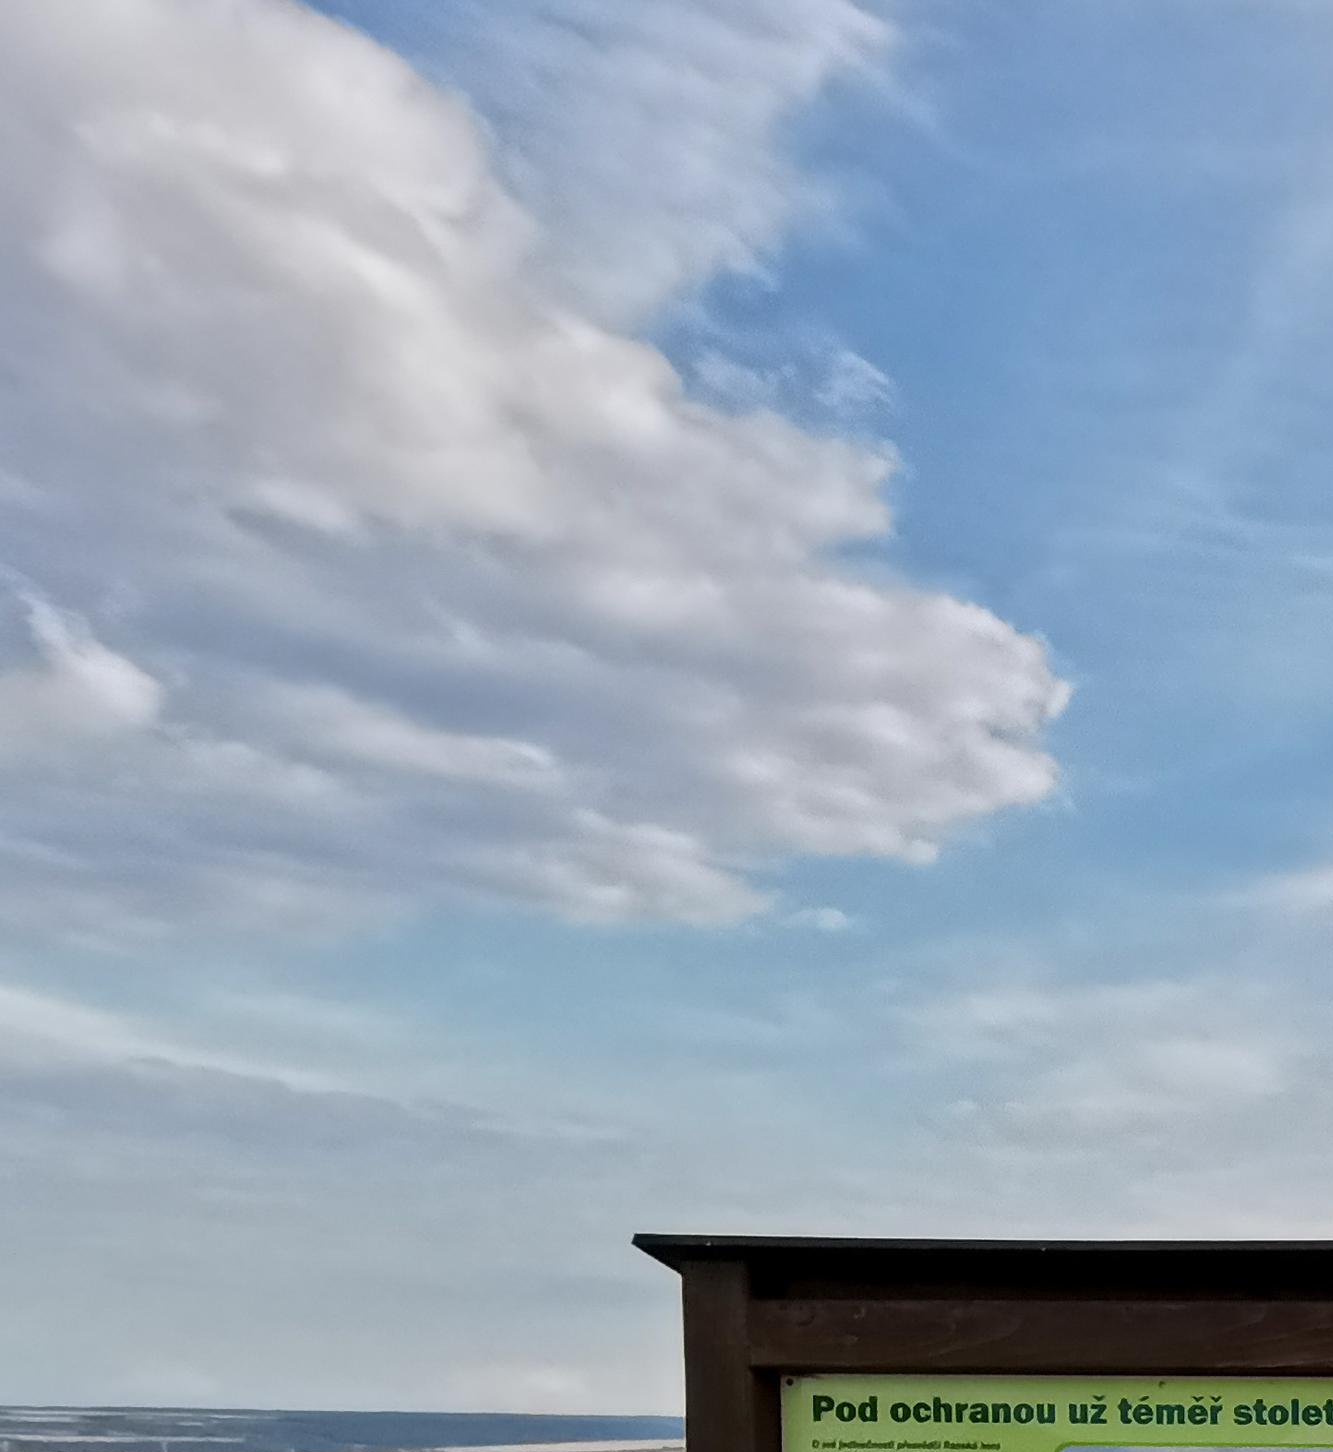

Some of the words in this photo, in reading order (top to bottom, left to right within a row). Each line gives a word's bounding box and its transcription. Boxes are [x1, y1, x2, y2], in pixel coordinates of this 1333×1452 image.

[812, 1395, 878, 1423] Pod
[889, 1396, 1055, 1424] ochranou
[1068, 1396, 1106, 1425] už
[1117, 1396, 1223, 1425] téměř
